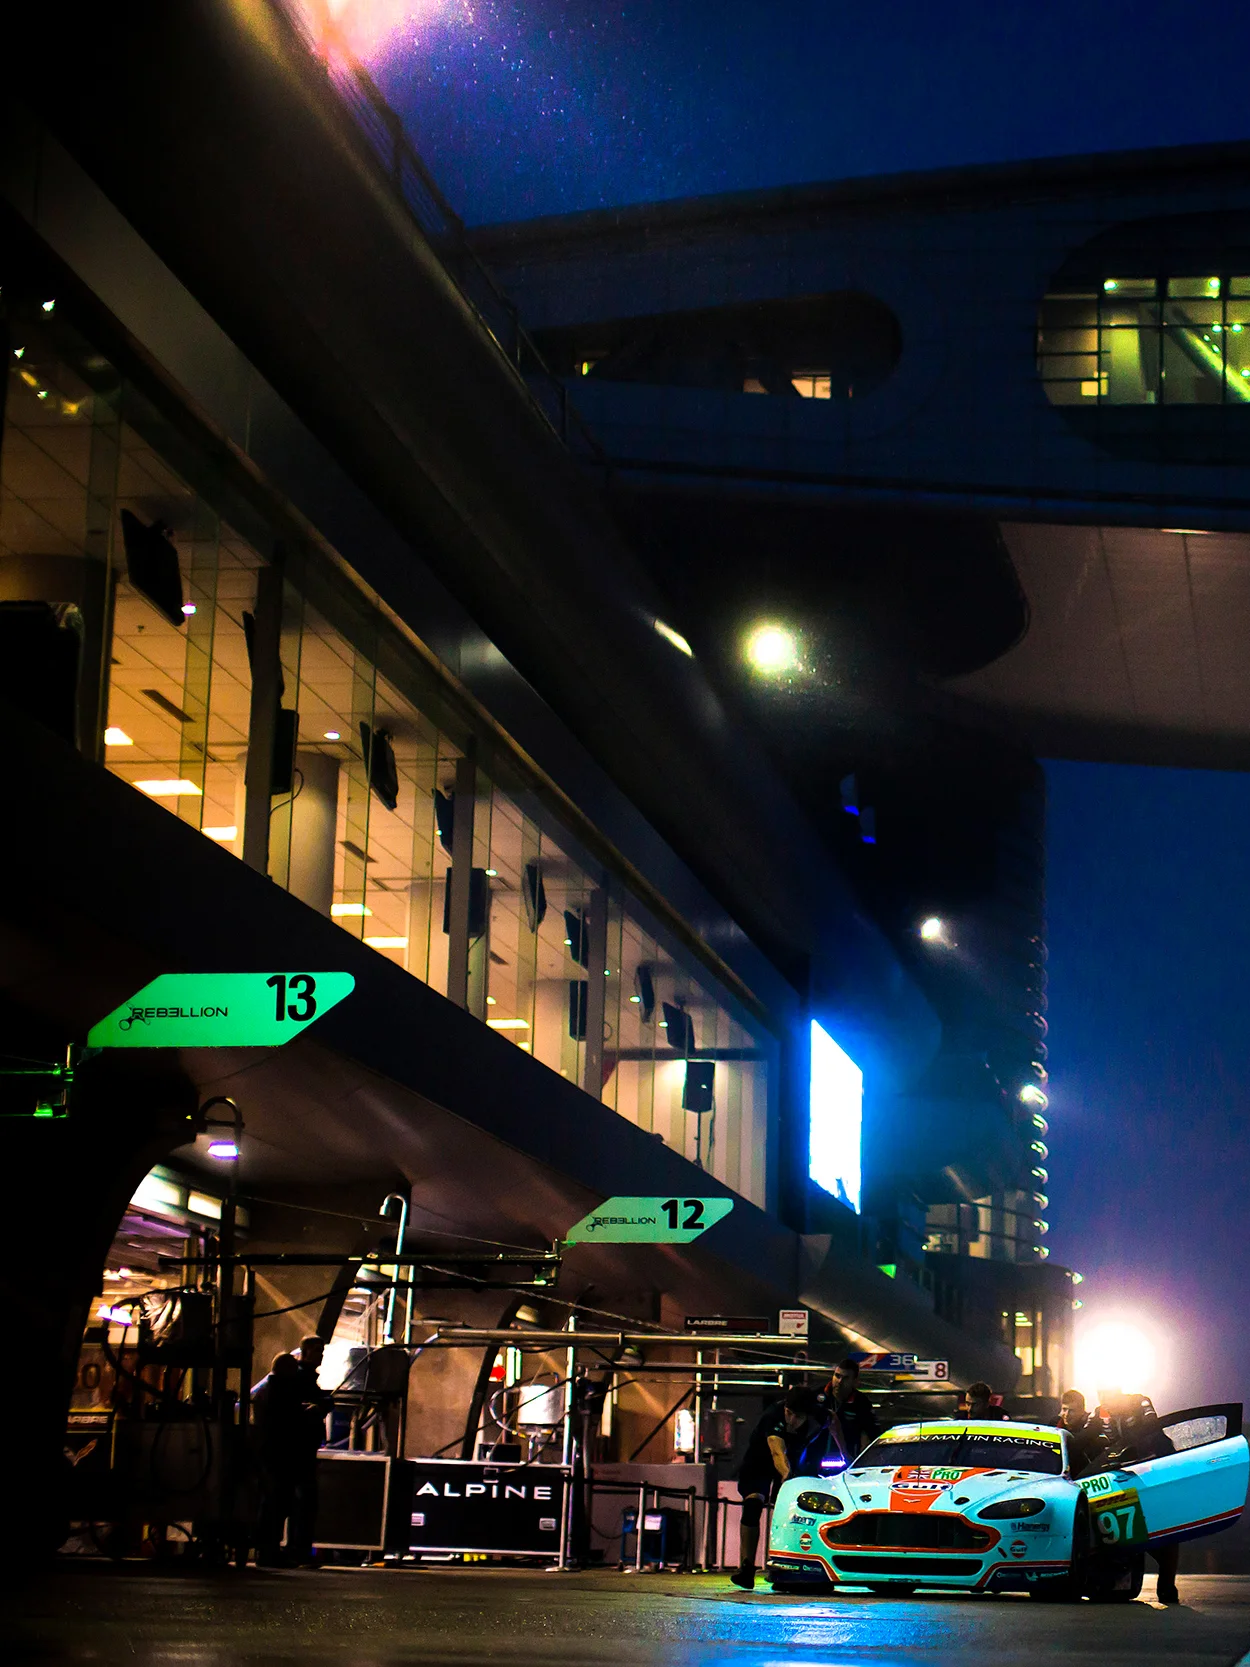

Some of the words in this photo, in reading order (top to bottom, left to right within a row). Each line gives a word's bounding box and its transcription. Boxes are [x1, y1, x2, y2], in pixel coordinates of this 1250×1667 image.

[130, 1006, 228, 1018] REBELLION
[266, 974, 317, 1022] 13
[594, 1216, 656, 1225] REBELLION
[660, 1199, 705, 1230] 12
[687, 1319, 728, 1327] LARBRE
[889, 1354, 914, 1366] 36
[935, 1362, 947, 1378] 8
[993, 1436, 1055, 1449] RACING
[931, 1470, 961, 1480] PRO
[416, 1481, 552, 1500] ALPINE
[1081, 1476, 1110, 1495] PRO
[1097, 1505, 1136, 1545] 97
